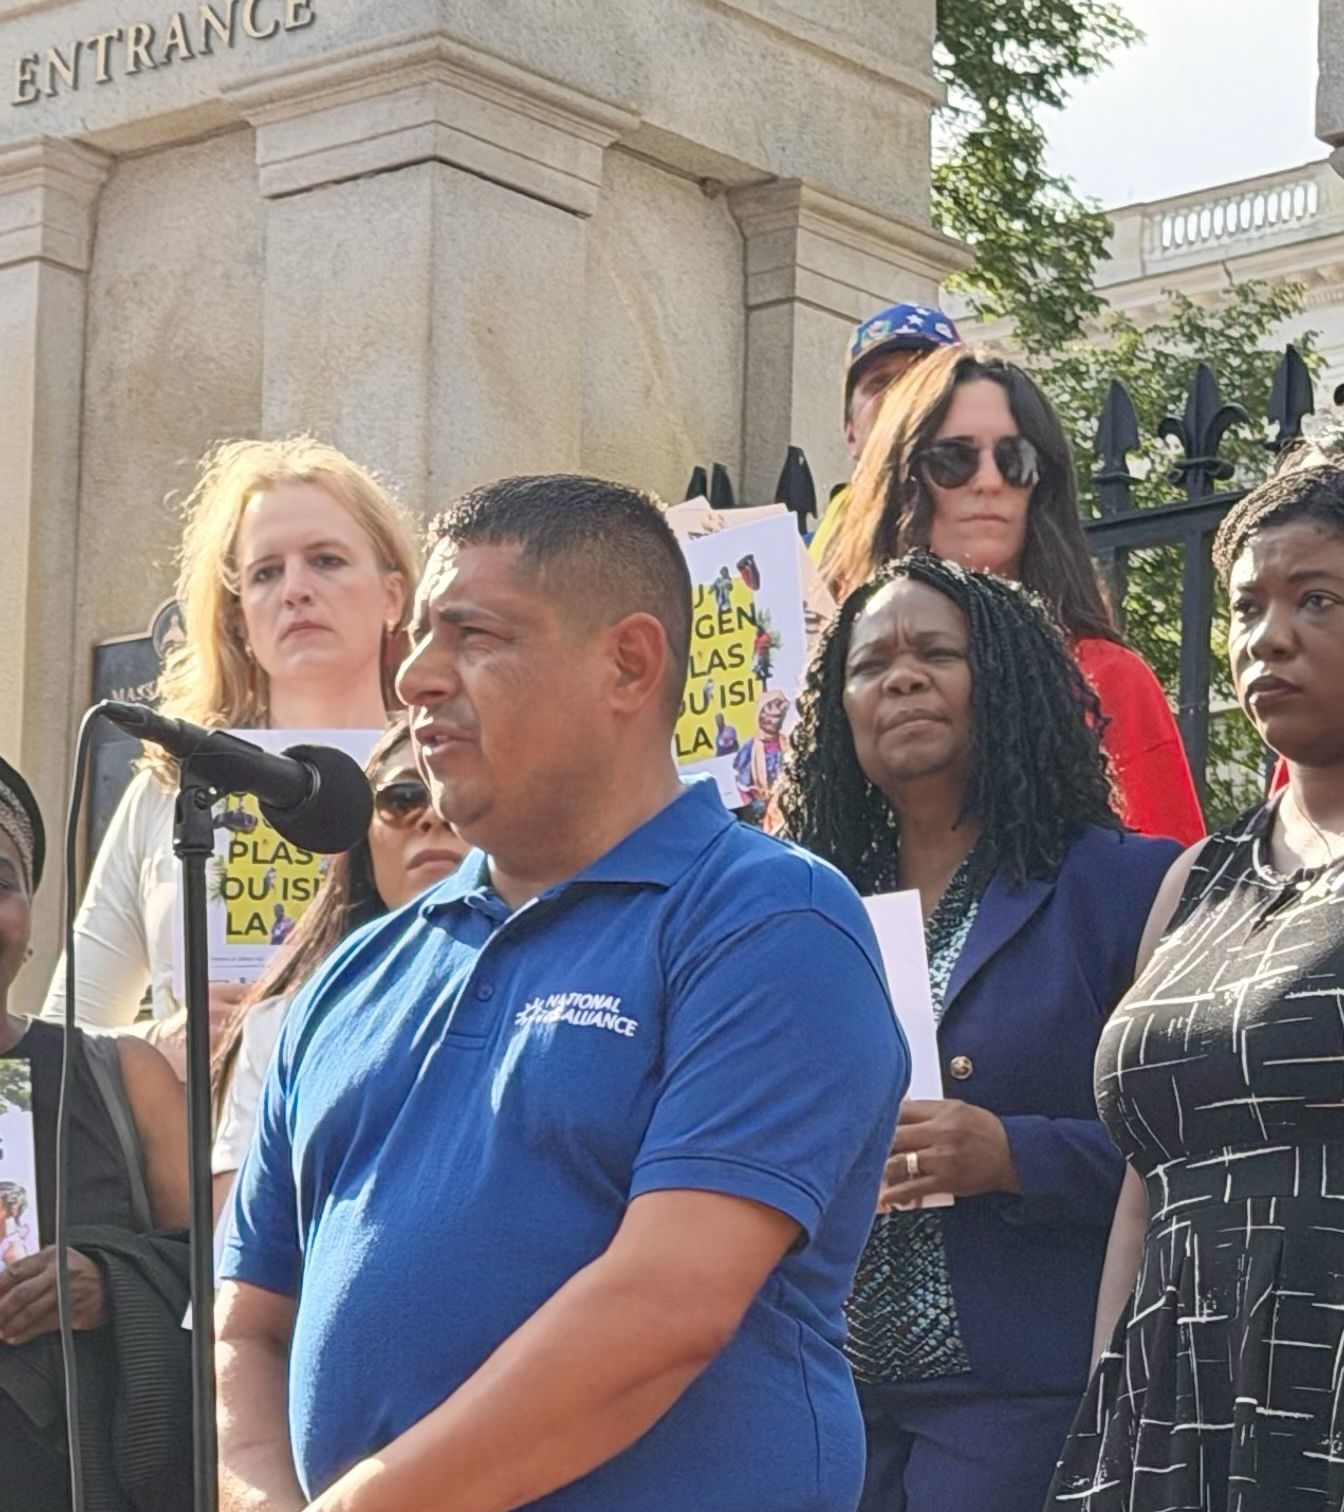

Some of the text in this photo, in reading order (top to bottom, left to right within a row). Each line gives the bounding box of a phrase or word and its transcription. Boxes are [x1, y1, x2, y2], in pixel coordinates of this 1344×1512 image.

[10, 0, 316, 107] ENTRANCE
[694, 602, 757, 640] GEN
[689, 643, 745, 679] LAS
[674, 727, 714, 757] LA
[219, 877, 325, 901] OU ISI
[226, 912, 268, 936] LA
[545, 992, 622, 1013] NATIONAL
[561, 1008, 639, 1037] ALLIANCE
